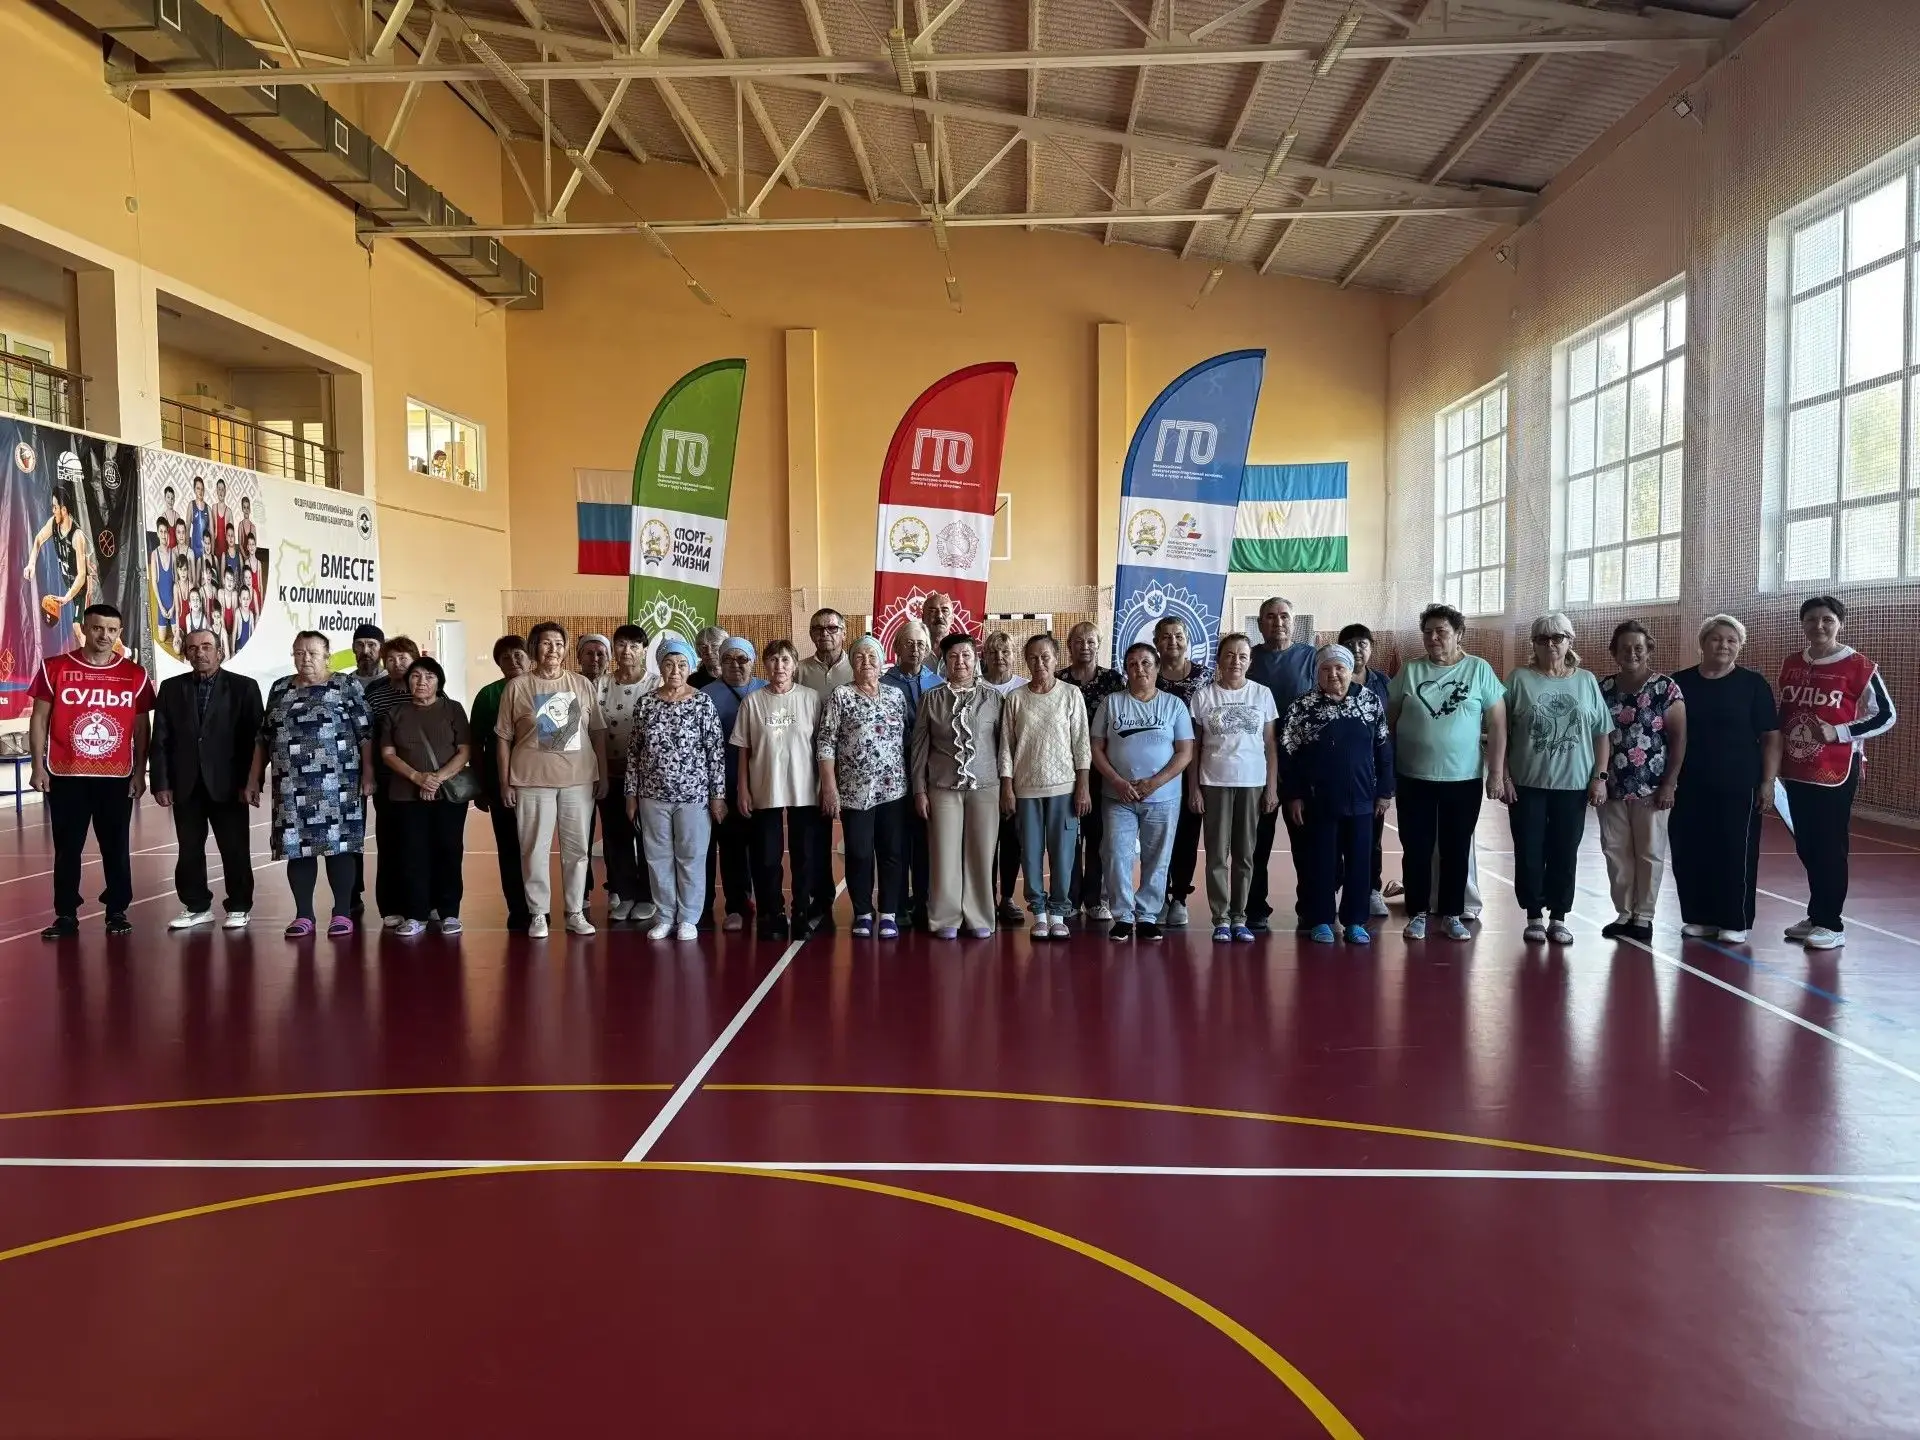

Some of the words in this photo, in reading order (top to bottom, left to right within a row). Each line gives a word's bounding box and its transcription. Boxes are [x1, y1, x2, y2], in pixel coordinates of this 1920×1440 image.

[658, 428, 709, 477] ГТО
[911, 428, 974, 474] ГТО
[1154, 419, 1218, 465] ГТО
[674, 527, 706, 544] СПОРТ
[673, 541, 712, 560] НОРМА
[320, 553, 375, 582] ВМЕСТЕ
[672, 554, 710, 573] ЖИЗНИ
[290, 585, 375, 607] олимпийским
[61, 687, 133, 709] СУДЬЯ
[1782, 685, 1844, 709] СУДЬЯ
